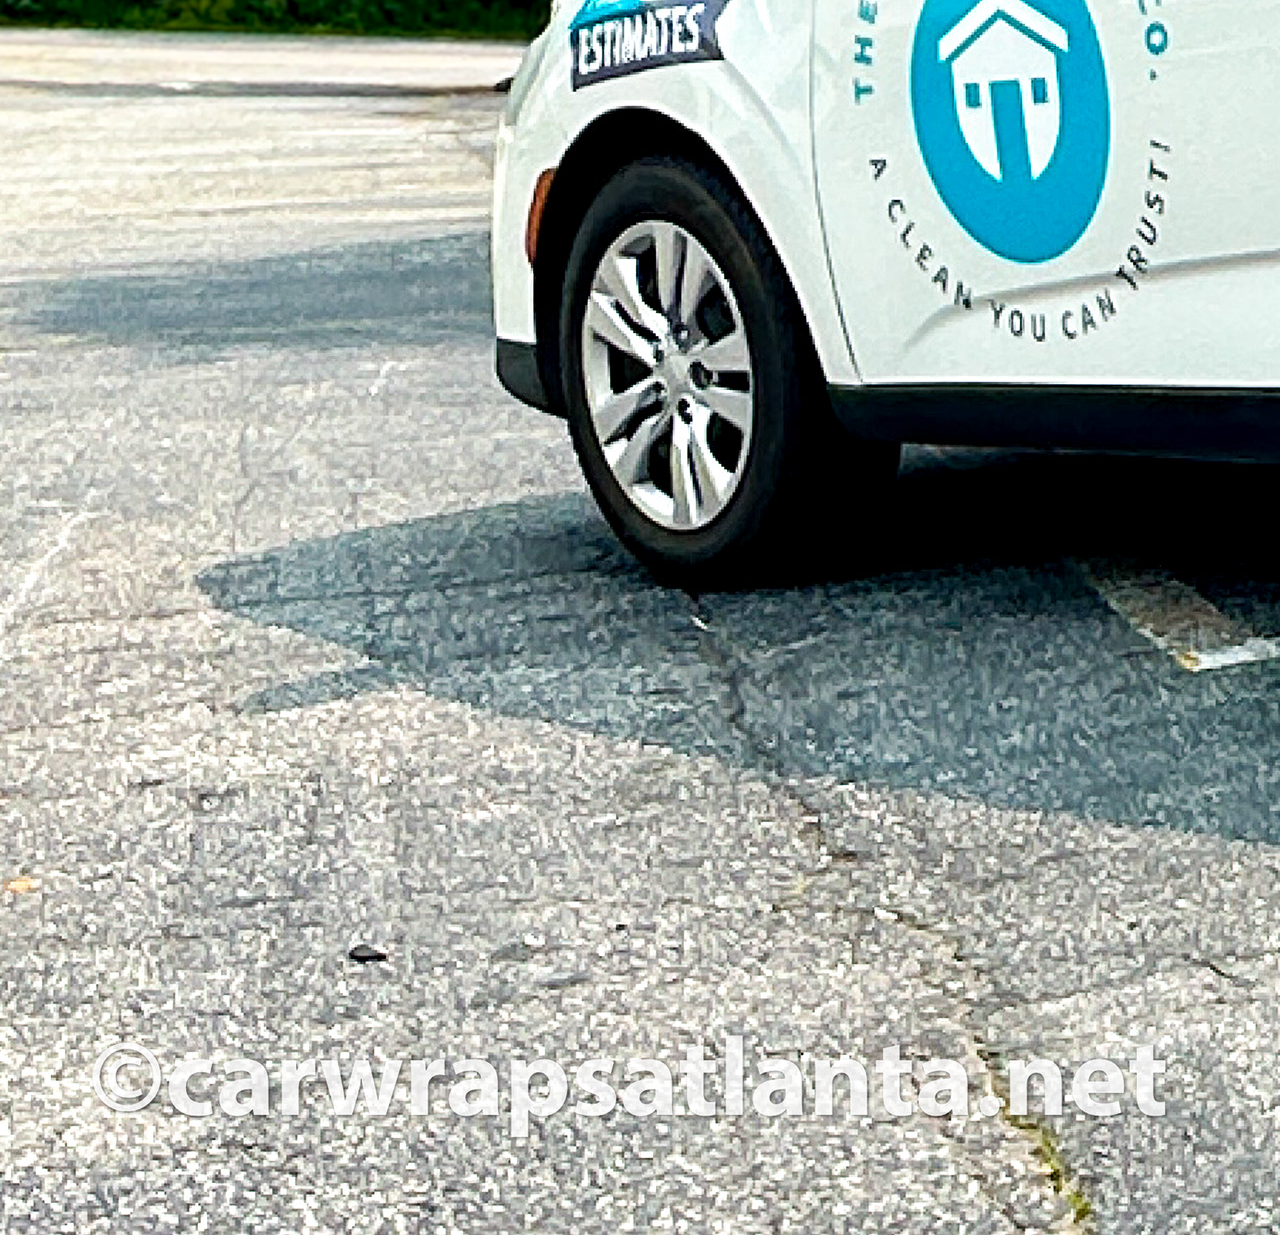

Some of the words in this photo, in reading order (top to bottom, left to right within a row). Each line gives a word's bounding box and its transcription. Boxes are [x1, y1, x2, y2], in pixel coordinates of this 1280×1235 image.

[578, 2, 706, 75] ESTIMATES
[869, 157, 888, 181] A
[887, 199, 973, 310] CLEAN
[990, 302, 1047, 343] YOU
[1061, 296, 1118, 340] CAN
[1115, 138, 1172, 292] TRUST!
